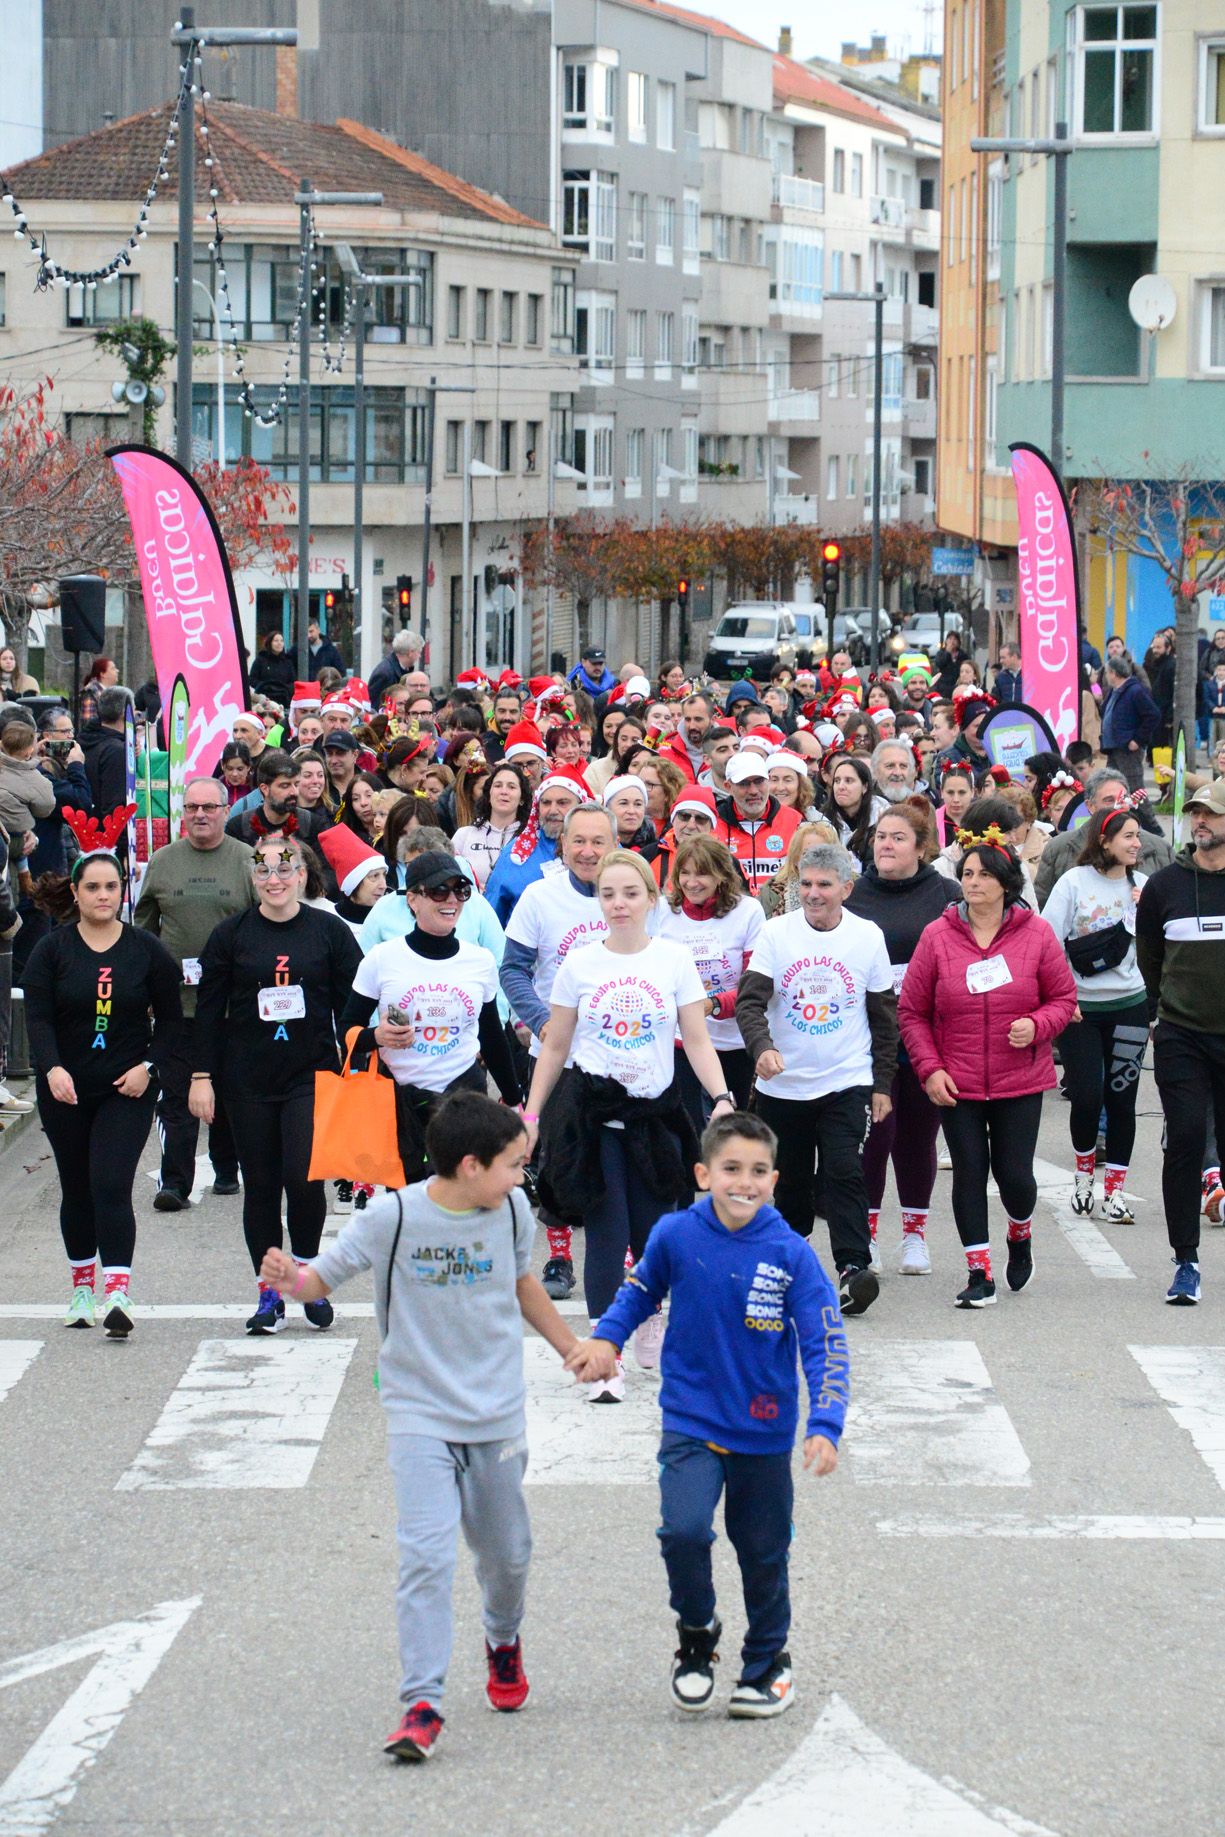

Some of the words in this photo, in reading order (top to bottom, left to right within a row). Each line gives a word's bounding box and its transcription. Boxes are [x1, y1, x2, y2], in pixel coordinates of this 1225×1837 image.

[557, 923, 587, 957] EQUIPO
[428, 983, 449, 993] LAS
[781, 957, 811, 989] EQUIPO
[813, 955, 833, 968] LAS
[832, 961, 856, 995] CHICAS
[91, 967, 113, 1050] ZUMBA
[274, 955, 290, 1041] ZUA
[589, 980, 617, 1009] EQUIPO
[618, 976, 637, 987] LAS
[638, 980, 665, 1010] CHICAS
[602, 1013, 652, 1037] 2025
[606, 1036, 621, 1049] LOS
[623, 1031, 656, 1050] CHICOS
[791, 1017, 809, 1033] LOS
[809, 1016, 843, 1035] CHICOS
